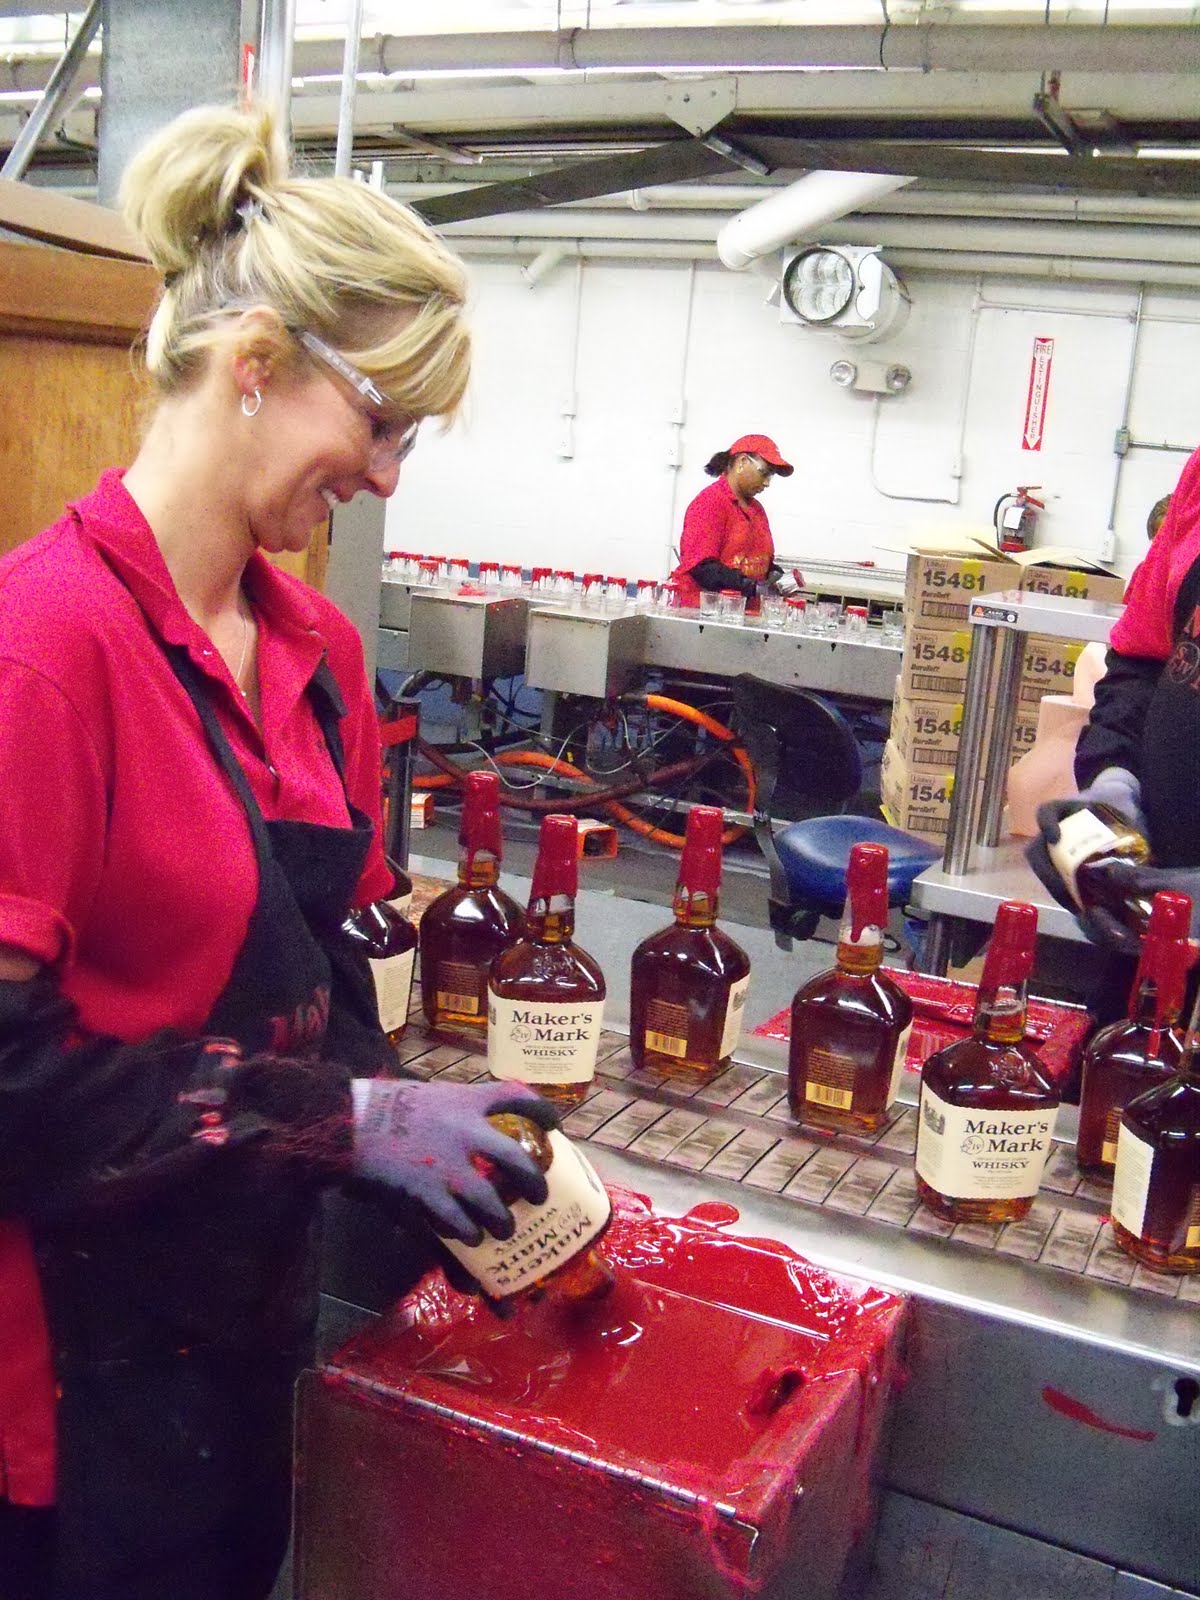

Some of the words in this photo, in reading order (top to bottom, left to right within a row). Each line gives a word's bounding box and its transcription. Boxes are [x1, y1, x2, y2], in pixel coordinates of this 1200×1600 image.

[1035, 344, 1052, 355] FIRE
[1029, 356, 1044, 439] EXTINGUISHER
[923, 569, 986, 591] 15481
[912, 643, 970, 663] 1548
[511, 1009, 593, 1026] Maker's
[534, 1028, 591, 1042] Mark
[521, 1048, 578, 1057] WHISKY
[964, 1119, 1049, 1135] Maker's
[986, 1138, 1043, 1153] Mark
[972, 1160, 1030, 1170] WHISKY
